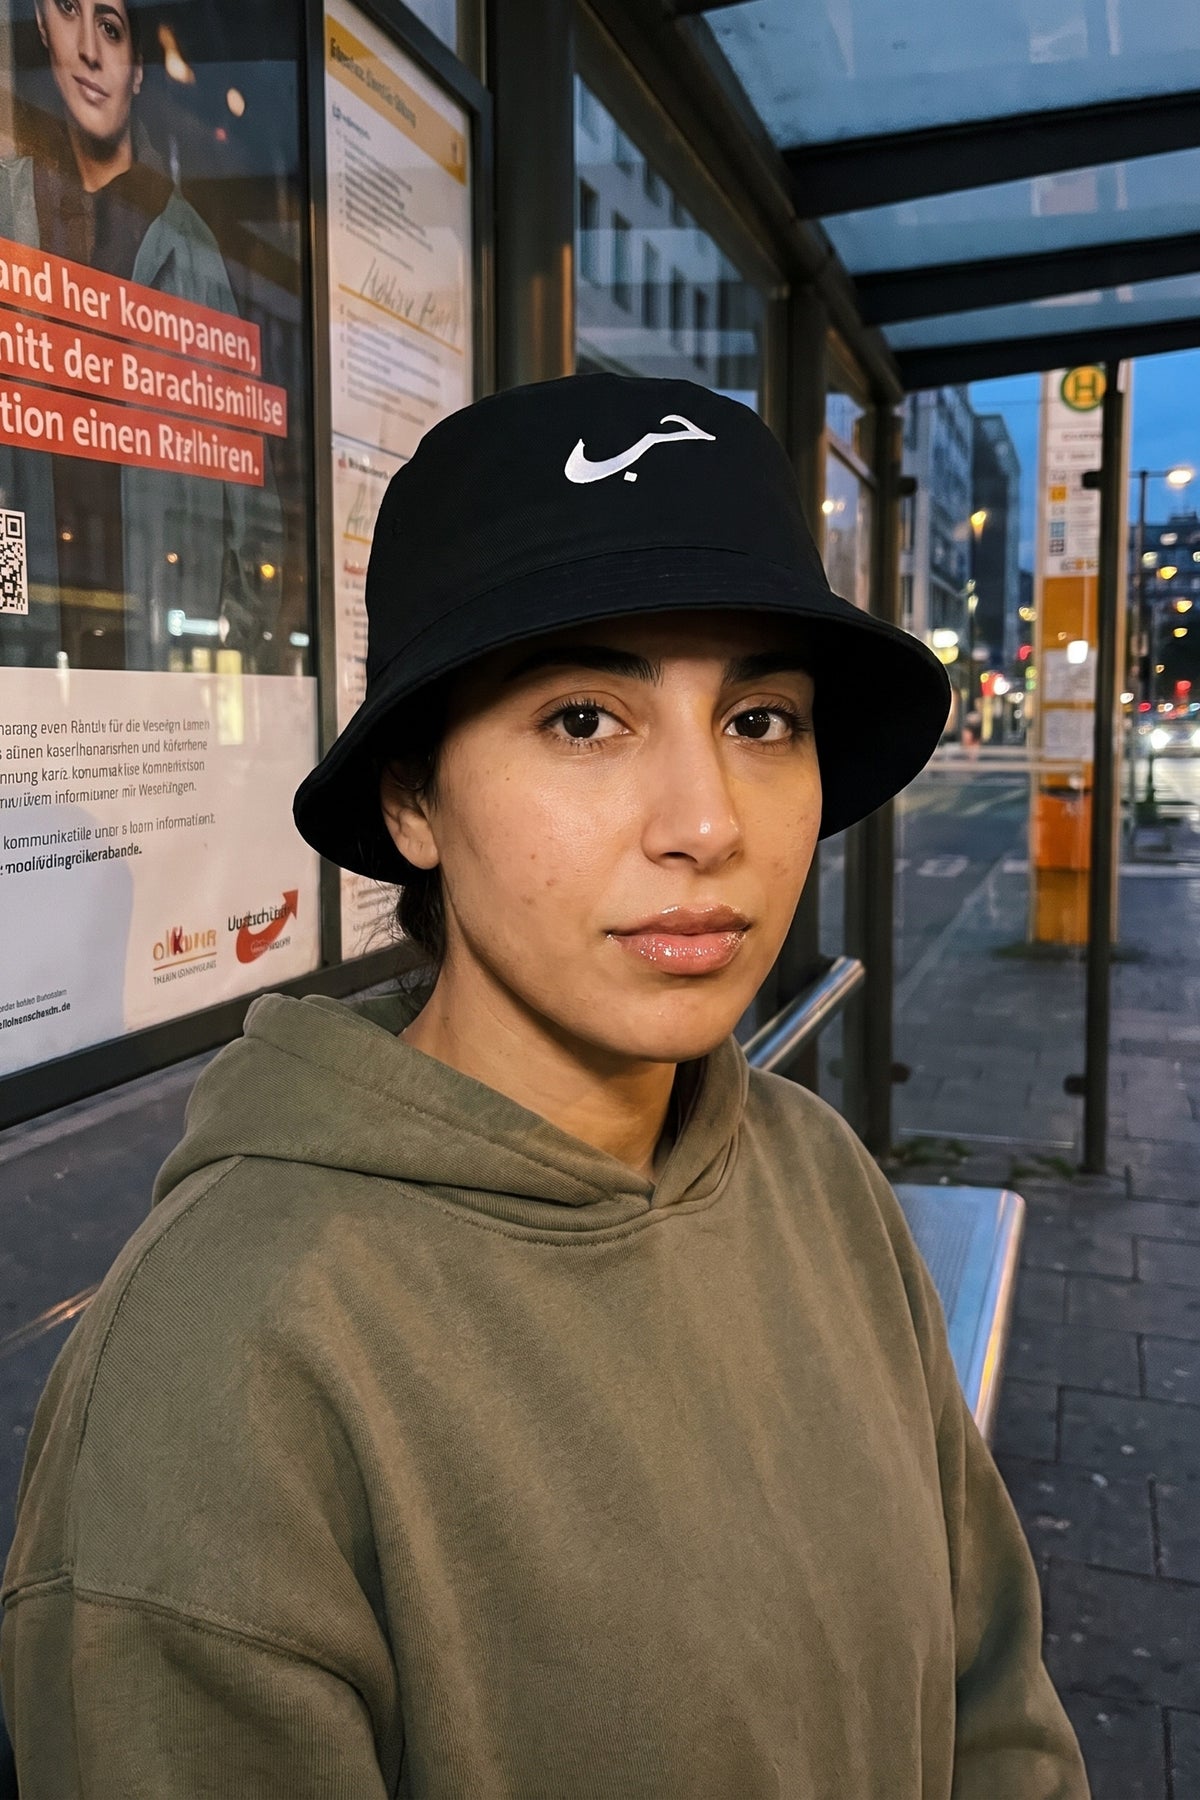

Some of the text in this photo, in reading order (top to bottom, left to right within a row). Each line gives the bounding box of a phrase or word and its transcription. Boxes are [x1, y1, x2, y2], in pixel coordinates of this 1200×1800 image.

[0, 258, 257, 372] and her kompanen,
[64, 338, 113, 385] der
[1074, 373, 1097, 403] H
[0, 391, 63, 442] tion
[73, 408, 151, 457] einen
[40, 723, 67, 734] even
[109, 719, 123, 733] für
[126, 719, 140, 732] die
[142, 740, 160, 753] und
